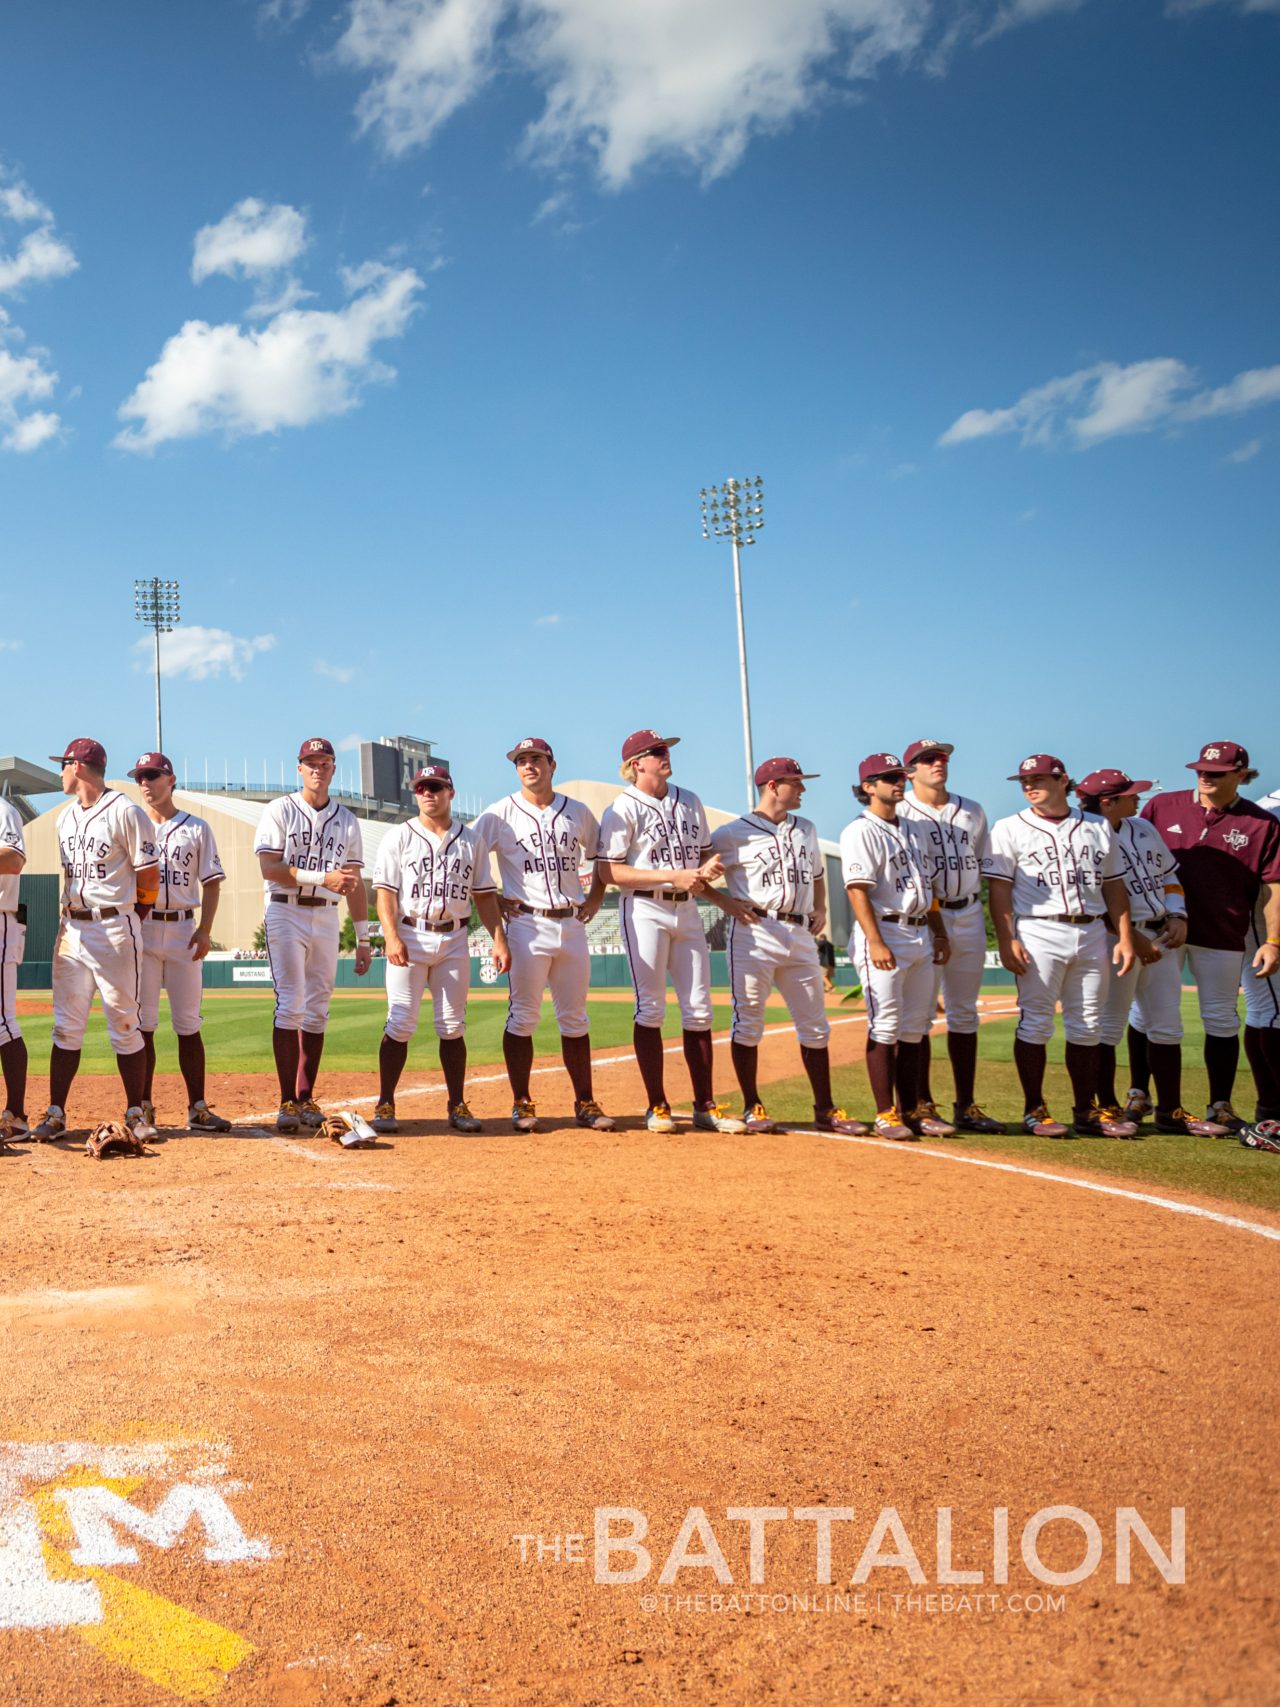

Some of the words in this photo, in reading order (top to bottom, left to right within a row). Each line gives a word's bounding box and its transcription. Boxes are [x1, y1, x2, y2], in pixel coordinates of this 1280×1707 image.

[516, 830, 578, 854] TEXAS
[643, 820, 699, 842] TEXAS
[289, 831, 344, 857] TEXAS
[651, 845, 700, 863] AGGIES
[1028, 844, 1105, 866] TEXAS
[408, 855, 473, 880] TEXAS
[524, 856, 575, 874] AGGIES
[1036, 870, 1102, 888] AGGIES
[411, 881, 468, 900] AGGIES
